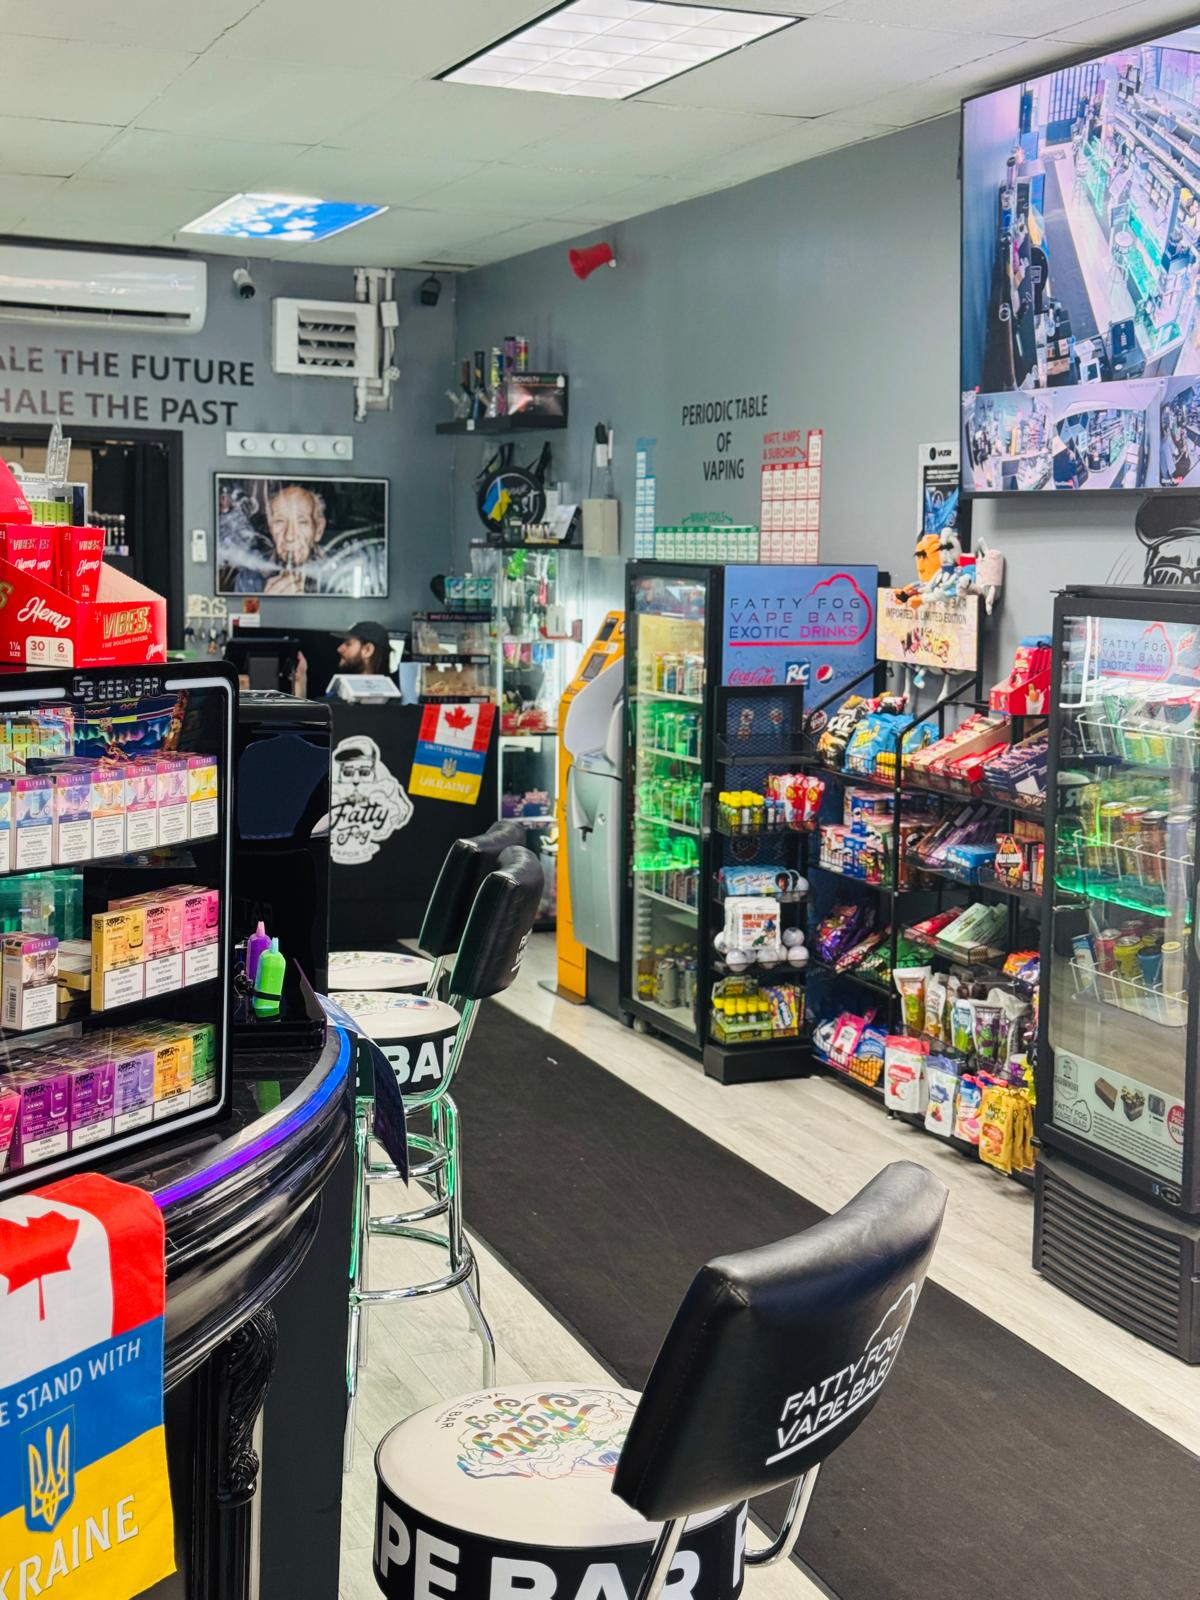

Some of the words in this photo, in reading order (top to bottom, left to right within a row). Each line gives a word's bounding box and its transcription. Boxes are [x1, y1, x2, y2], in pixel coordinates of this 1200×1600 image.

[54, 348, 119, 378] THE
[132, 353, 254, 387] FUTURE
[85, 392, 148, 421] THE
[161, 397, 239, 427] PAST
[681, 400, 733, 427] PERIODIC
[736, 394, 768, 419] TABLE
[716, 431, 732, 453] OF
[703, 458, 745, 482] VAPING
[76, 558, 100, 577] Hemp
[730, 597, 803, 609] FATTY
[817, 598, 861, 609] FOG
[17, 597, 71, 632] Hemp
[103, 607, 149, 640] VIBES
[731, 612, 793, 623] VAPE
[808, 612, 854, 623] BAR
[729, 626, 789, 639] EXOTIC
[800, 625, 859, 639] DRINKS
[30, 640, 45, 651] 30
[57, 642, 65, 653] 6
[146, 642, 165, 661] Hemp
[1102, 638, 1137, 650] FATTY
[1144, 641, 1168, 653] FOG
[786, 664, 810, 685] RC
[98, 678, 134, 699] GEEK
[135, 676, 161, 697] BAR
[420, 776, 471, 795] UKRAINE
[330, 801, 389, 831] Fatty
[336, 824, 370, 846] Fog
[1054, 1100, 1073, 1115] FATTY
[16, 1366, 83, 1419] STAND
[89, 1338, 141, 1380] WITH
[780, 1355, 865, 1422] FATTY
[863, 1325, 903, 1373] FOG
[777, 1390, 849, 1449] VAPE
[846, 1357, 891, 1408] BAR
